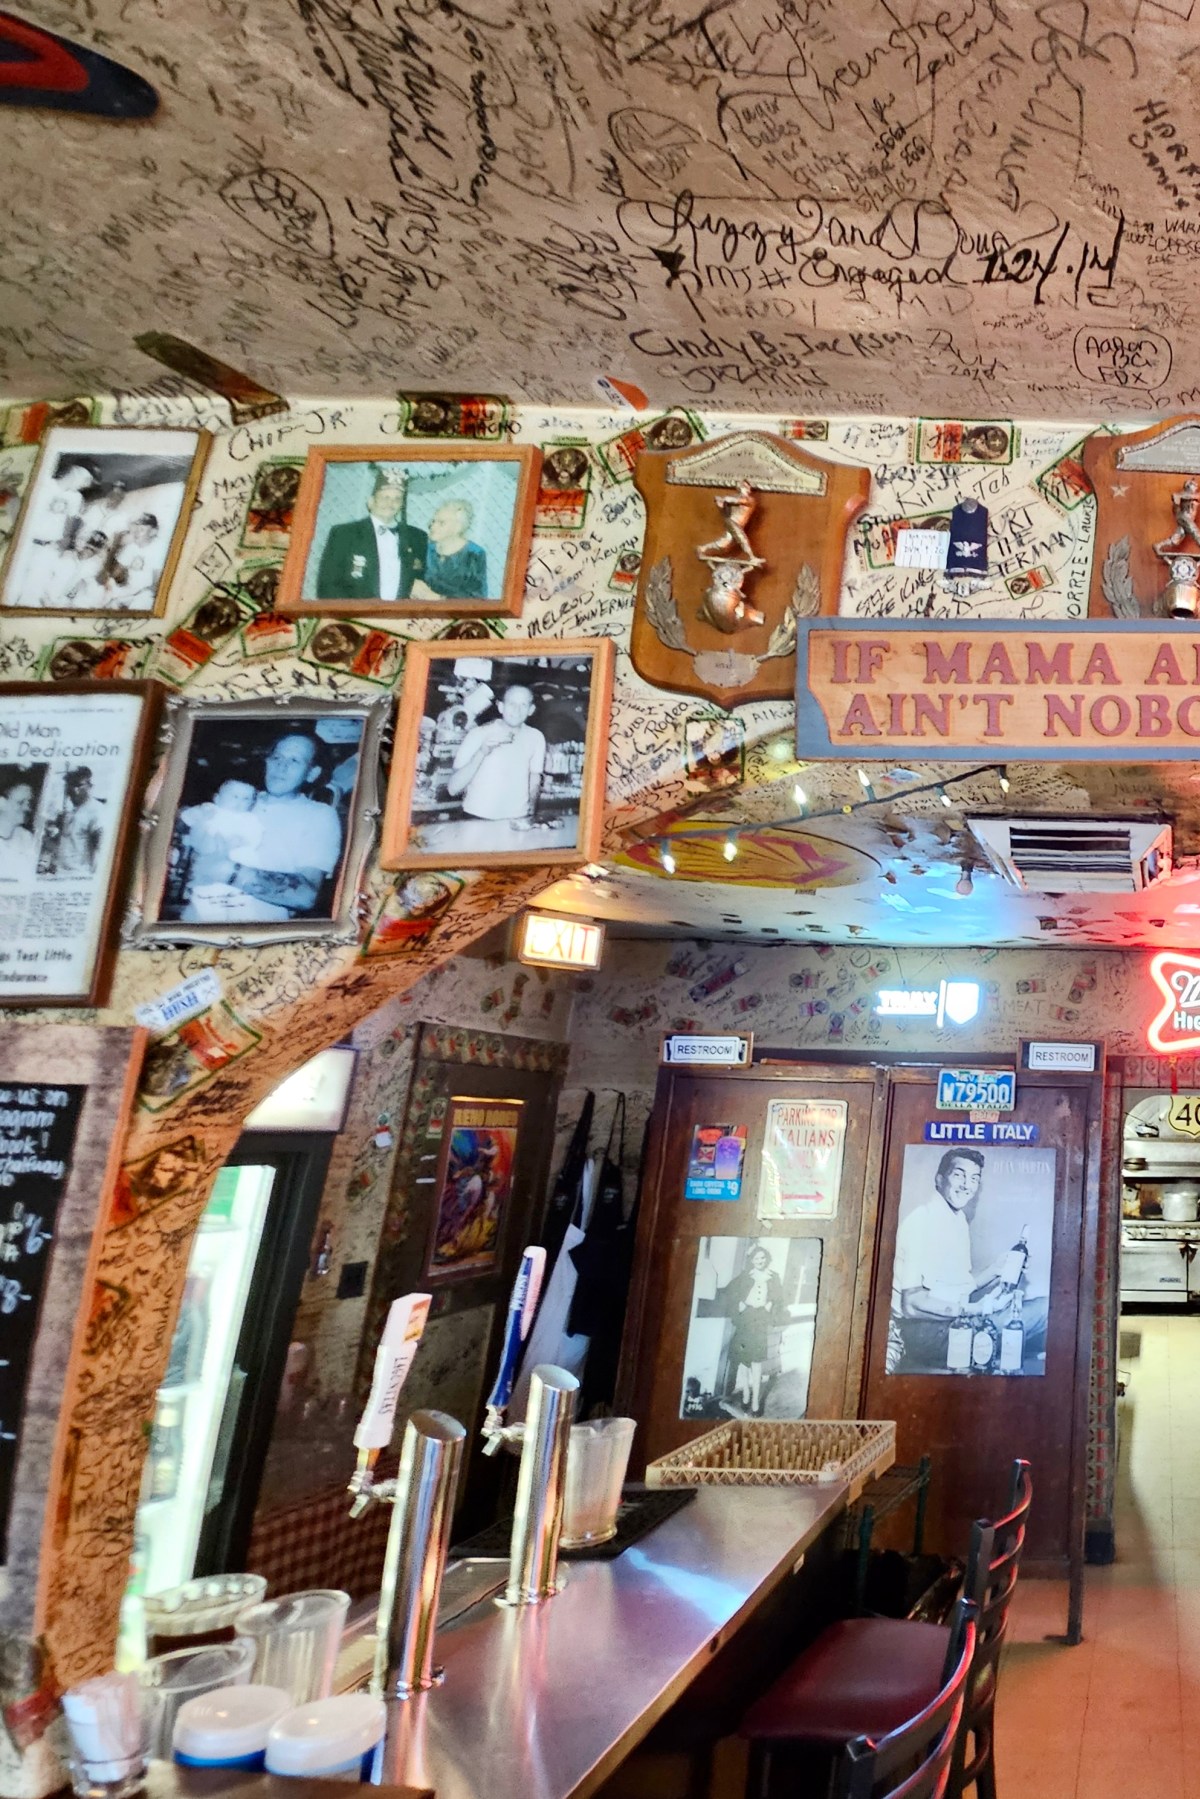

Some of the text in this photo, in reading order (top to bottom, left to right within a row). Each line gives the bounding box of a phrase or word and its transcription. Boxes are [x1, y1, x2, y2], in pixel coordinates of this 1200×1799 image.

[830, 640, 891, 684] IF
[922, 641, 1122, 685] MAMA
[837, 693, 1015, 737] AIN'T
[25, 723, 62, 739] Man
[17, 740, 120, 758] Dedication
[530, 918, 596, 961] EXIT
[677, 1044, 733, 1055] RESTROOM
[1035, 1051, 1089, 1063] RESTROOM
[774, 1129, 837, 1148] ITALIANS
[930, 1123, 1034, 1140] LITTLE ITALY
